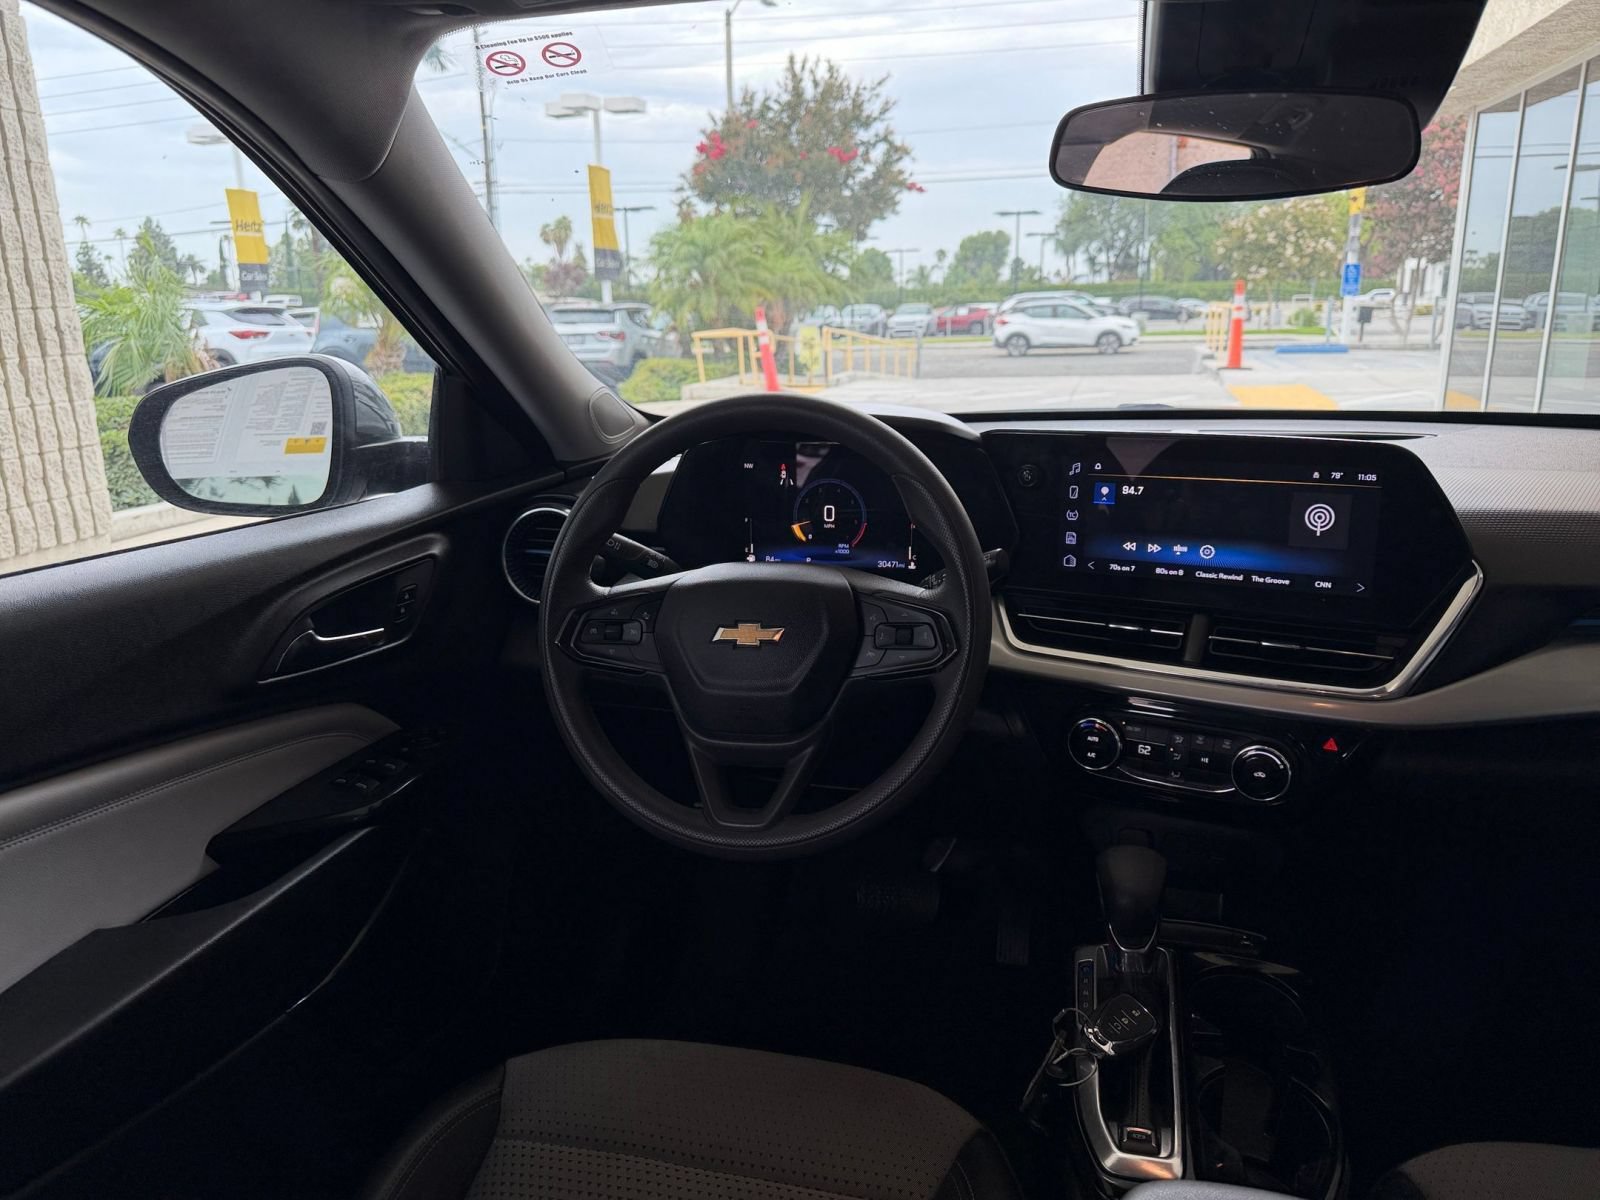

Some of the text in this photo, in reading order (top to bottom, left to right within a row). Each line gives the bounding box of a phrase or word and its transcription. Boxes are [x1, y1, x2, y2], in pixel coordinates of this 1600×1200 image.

[480, 41, 507, 49] Cleaning
[236, 219, 263, 232] Hertz
[1358, 473, 1377, 481] 11:05
[1122, 485, 1144, 495] 94.7
[824, 505, 835, 522] 0
[1109, 563, 1121, 571] 70s
[1155, 567, 1168, 575] 80s
[1195, 570, 1243, 581] Classic Rewind
[1251, 575, 1290, 586] The Groove
[1314, 581, 1332, 589] CNN
[1137, 744, 1151, 755] 62
